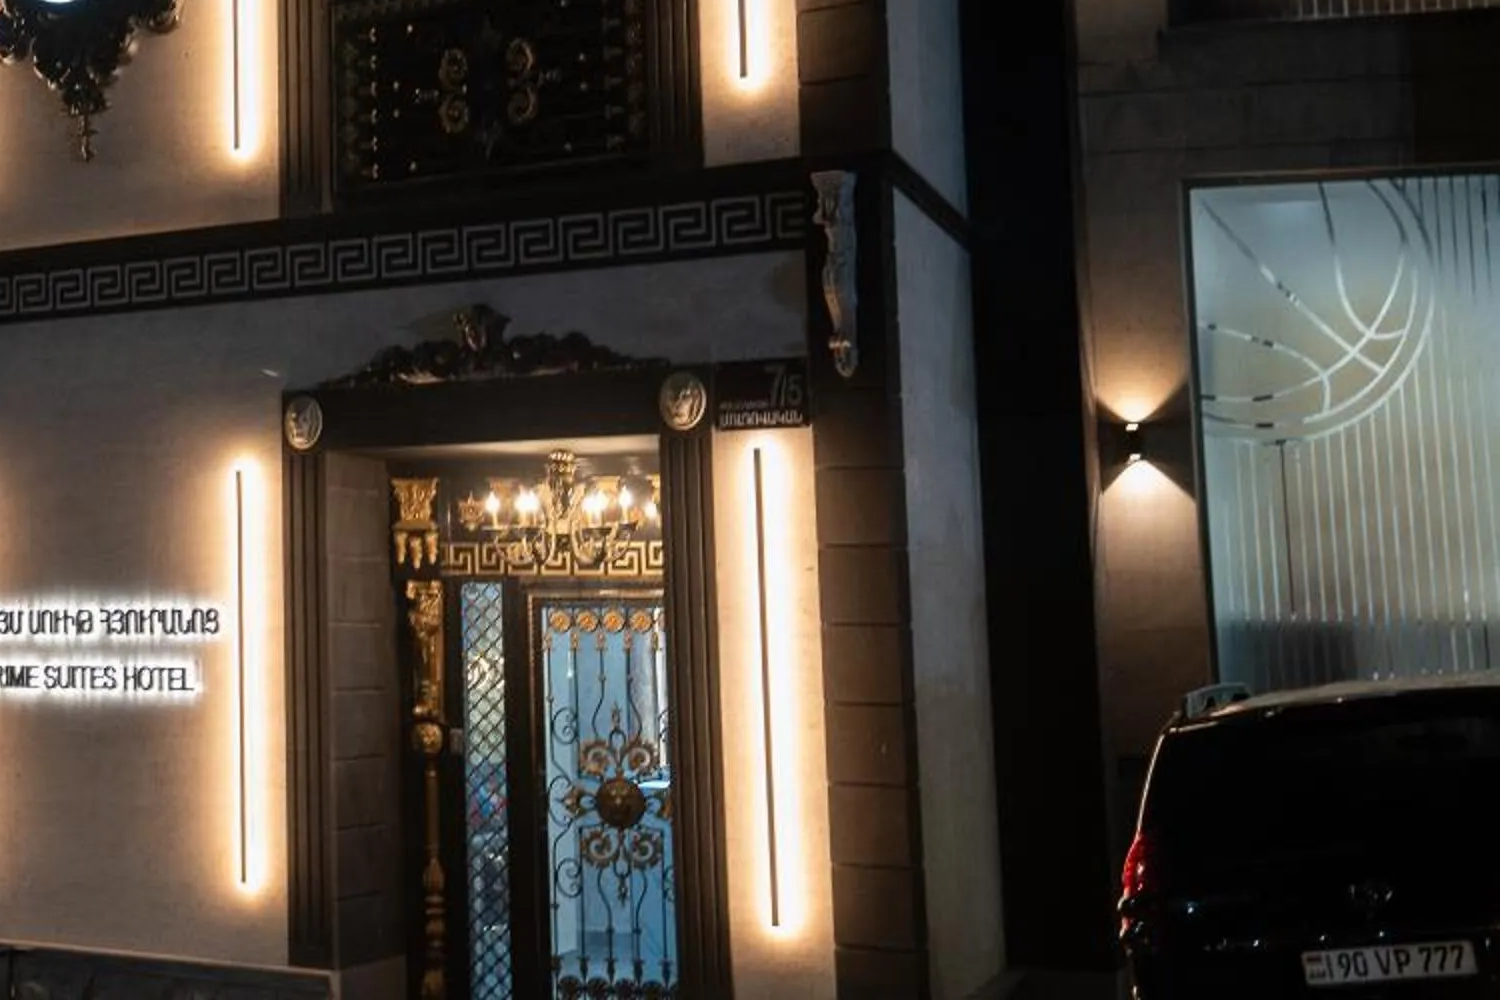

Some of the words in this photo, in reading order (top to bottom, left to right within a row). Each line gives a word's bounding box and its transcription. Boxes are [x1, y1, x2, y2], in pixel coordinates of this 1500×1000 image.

[29, 609, 93, 635] ՍՈՒԻԹ
[100, 608, 219, 635] ՀՅՈՒՐԱՆՈՑ
[44, 665, 117, 691] SUITES
[123, 666, 194, 692] HOTEL
[1338, 951, 1368, 978] 90
[1374, 948, 1410, 975] VP
[1418, 945, 1463, 972] 777
